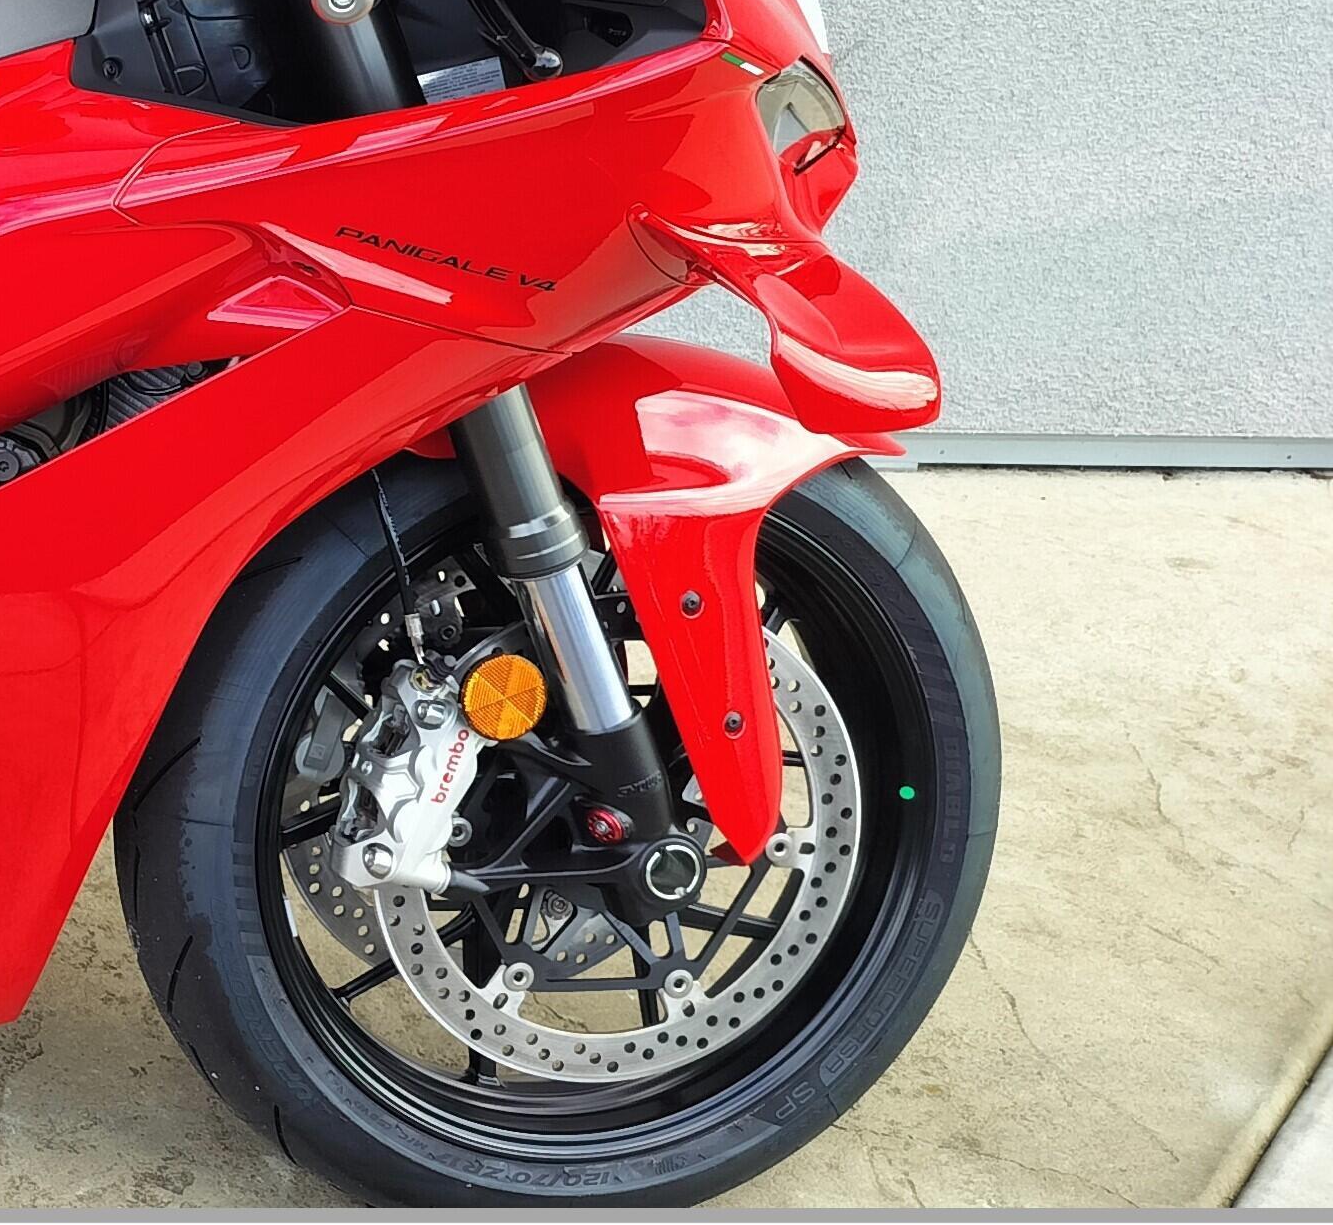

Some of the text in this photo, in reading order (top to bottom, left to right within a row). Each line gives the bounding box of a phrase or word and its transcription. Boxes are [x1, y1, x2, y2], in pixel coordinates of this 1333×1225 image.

[335, 227, 557, 291] PANIGALE V4
[431, 729, 469, 803] brembo
[773, 892, 943, 1121] SUPERCORSA SP
[513, 1171, 610, 1187] 120/70
